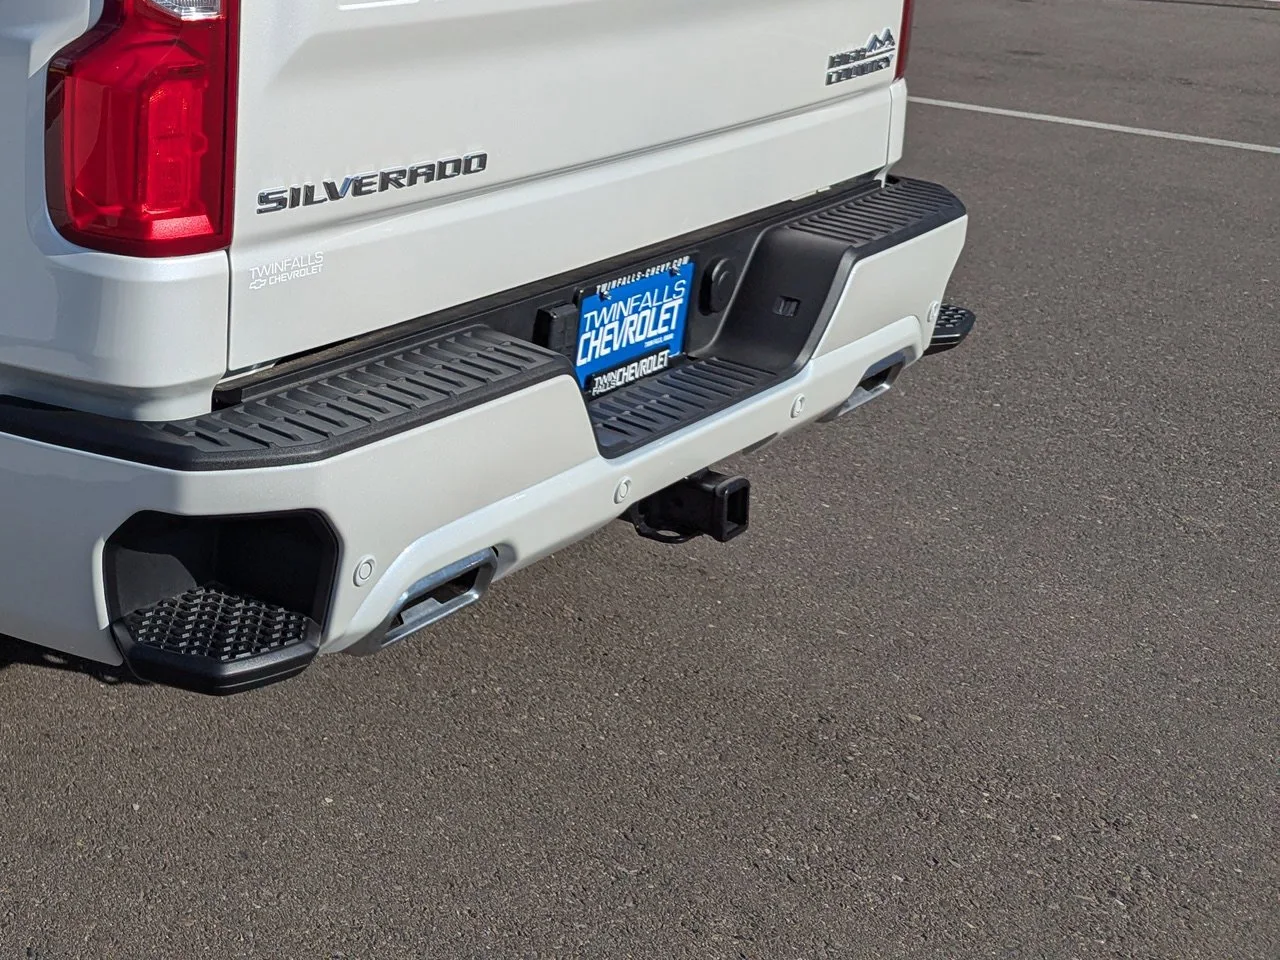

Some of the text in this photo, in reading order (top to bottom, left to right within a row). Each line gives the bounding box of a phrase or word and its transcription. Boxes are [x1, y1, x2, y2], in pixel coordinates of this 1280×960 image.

[257, 149, 488, 215] SILVERADO
[269, 264, 324, 286] CHEVROLET
[576, 298, 684, 367] CHEVROLET
[593, 349, 671, 388] TWIN CHEVROLET
